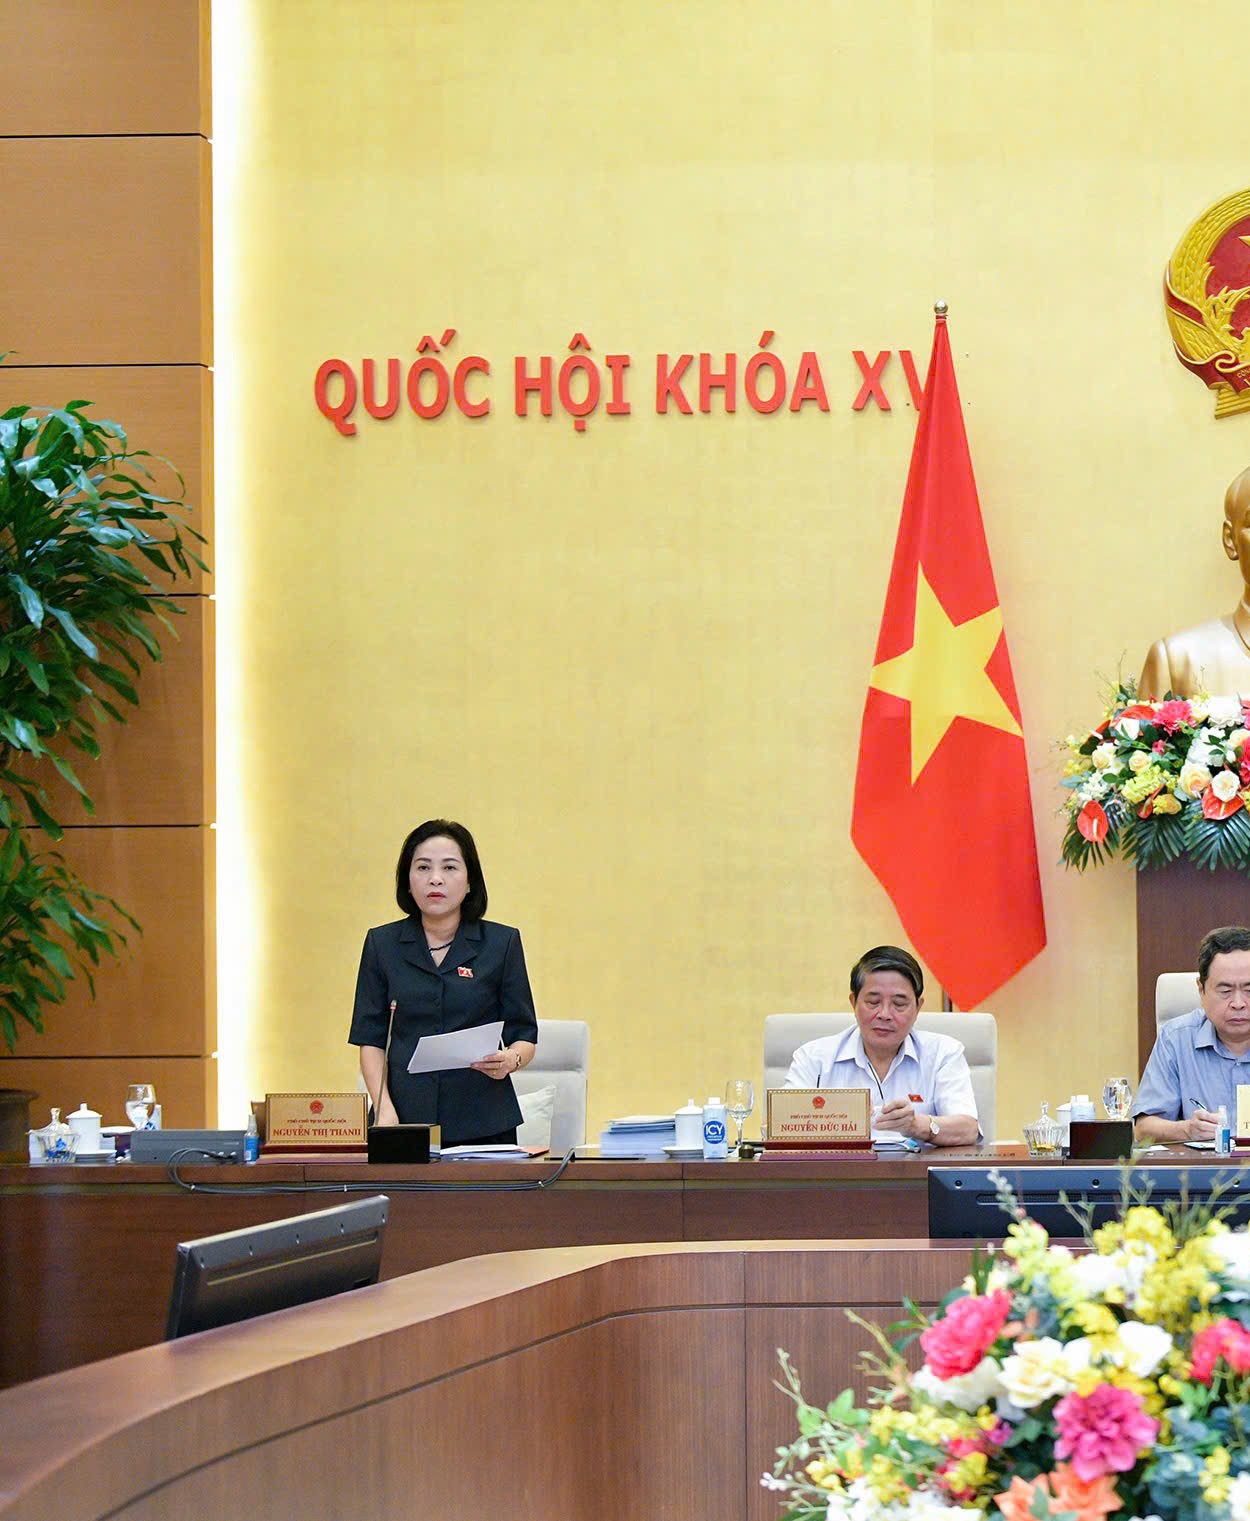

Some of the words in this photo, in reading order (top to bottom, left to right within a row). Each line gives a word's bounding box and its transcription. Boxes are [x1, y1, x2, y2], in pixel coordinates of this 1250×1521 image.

[313, 329, 491, 436] QUỐC
[514, 332, 631, 431] HỘI
[655, 330, 830, 413] KHÓA
[706, 1124, 723, 1135] ICY
[820, 1122, 839, 1132] ĐỨC
[841, 1120, 857, 1132] HẢI
[312, 1128, 328, 1137] THỊ
[330, 1128, 361, 1136] THANH
